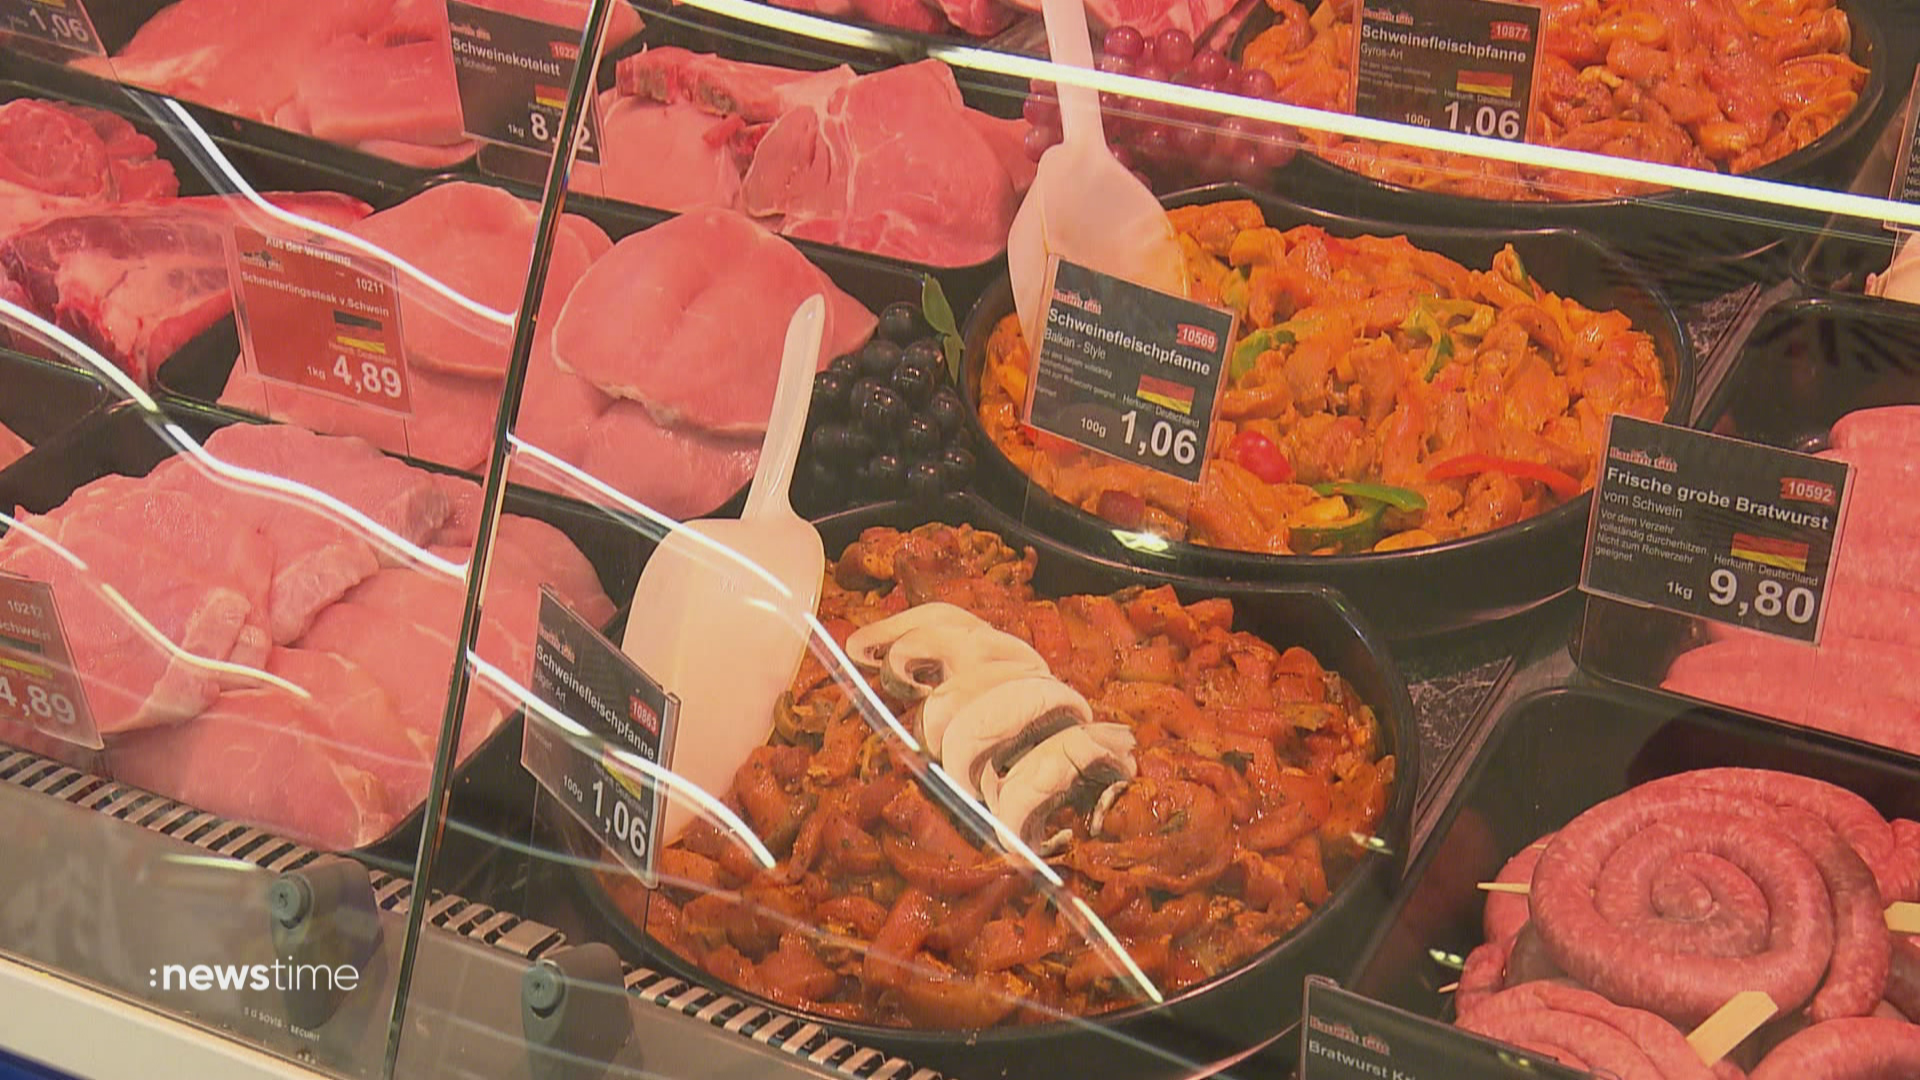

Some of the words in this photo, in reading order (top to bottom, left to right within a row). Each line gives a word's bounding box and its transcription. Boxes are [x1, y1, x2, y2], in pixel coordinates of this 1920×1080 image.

[29, 8, 89, 42] 1,06
[1496, 24, 1528, 39] 10877
[452, 37, 560, 76] Schweinekotelett
[1362, 25, 1526, 62] Schweinefleischpfanne
[508, 124, 524, 138] 1kg
[1405, 113, 1431, 128] 100g
[1444, 101, 1520, 139] 1,06
[265, 236, 284, 250] Aus
[286, 241, 302, 254] der
[304, 245, 352, 267] Werbung
[242, 271, 337, 304] Schmetterlingssteak
[355, 277, 384, 295] 10211
[1044, 327, 1075, 349] Balkan
[1083, 341, 1106, 360] Style
[1048, 308, 1211, 376] Schweinefleischpfanne
[306, 365, 326, 381] 1kg
[333, 354, 402, 398] 4,89
[1080, 416, 1106, 438] 100g
[1121, 410, 1197, 465] 1,06
[1603, 491, 1629, 506] vom
[1631, 495, 1683, 519] Schwein
[1607, 467, 1672, 495] Frische
[1677, 486, 1731, 509] grobe
[1736, 496, 1829, 530] Bratwurst
[1787, 481, 1832, 502] 10592
[1599, 521, 1644, 542] vollständig
[1600, 508, 1617, 521] Vor
[1617, 514, 1637, 527] dem
[1639, 518, 1675, 534] Verzehr
[1595, 545, 1633, 562] geeignet
[1597, 532, 1620, 547] Nicht
[1621, 540, 1640, 552] zum
[1641, 544, 1694, 564] Rohverzehr
[1666, 581, 1693, 600] 1kg
[1758, 565, 1818, 586] Deutschland
[1708, 569, 1816, 624] 9,80
[535, 643, 655, 761] Schweinefleischpfanne
[632, 700, 658, 733] 10863
[563, 774, 583, 803] 100g
[592, 779, 647, 858] 1,06
[1308, 1039, 1388, 1078] Bratwurst
